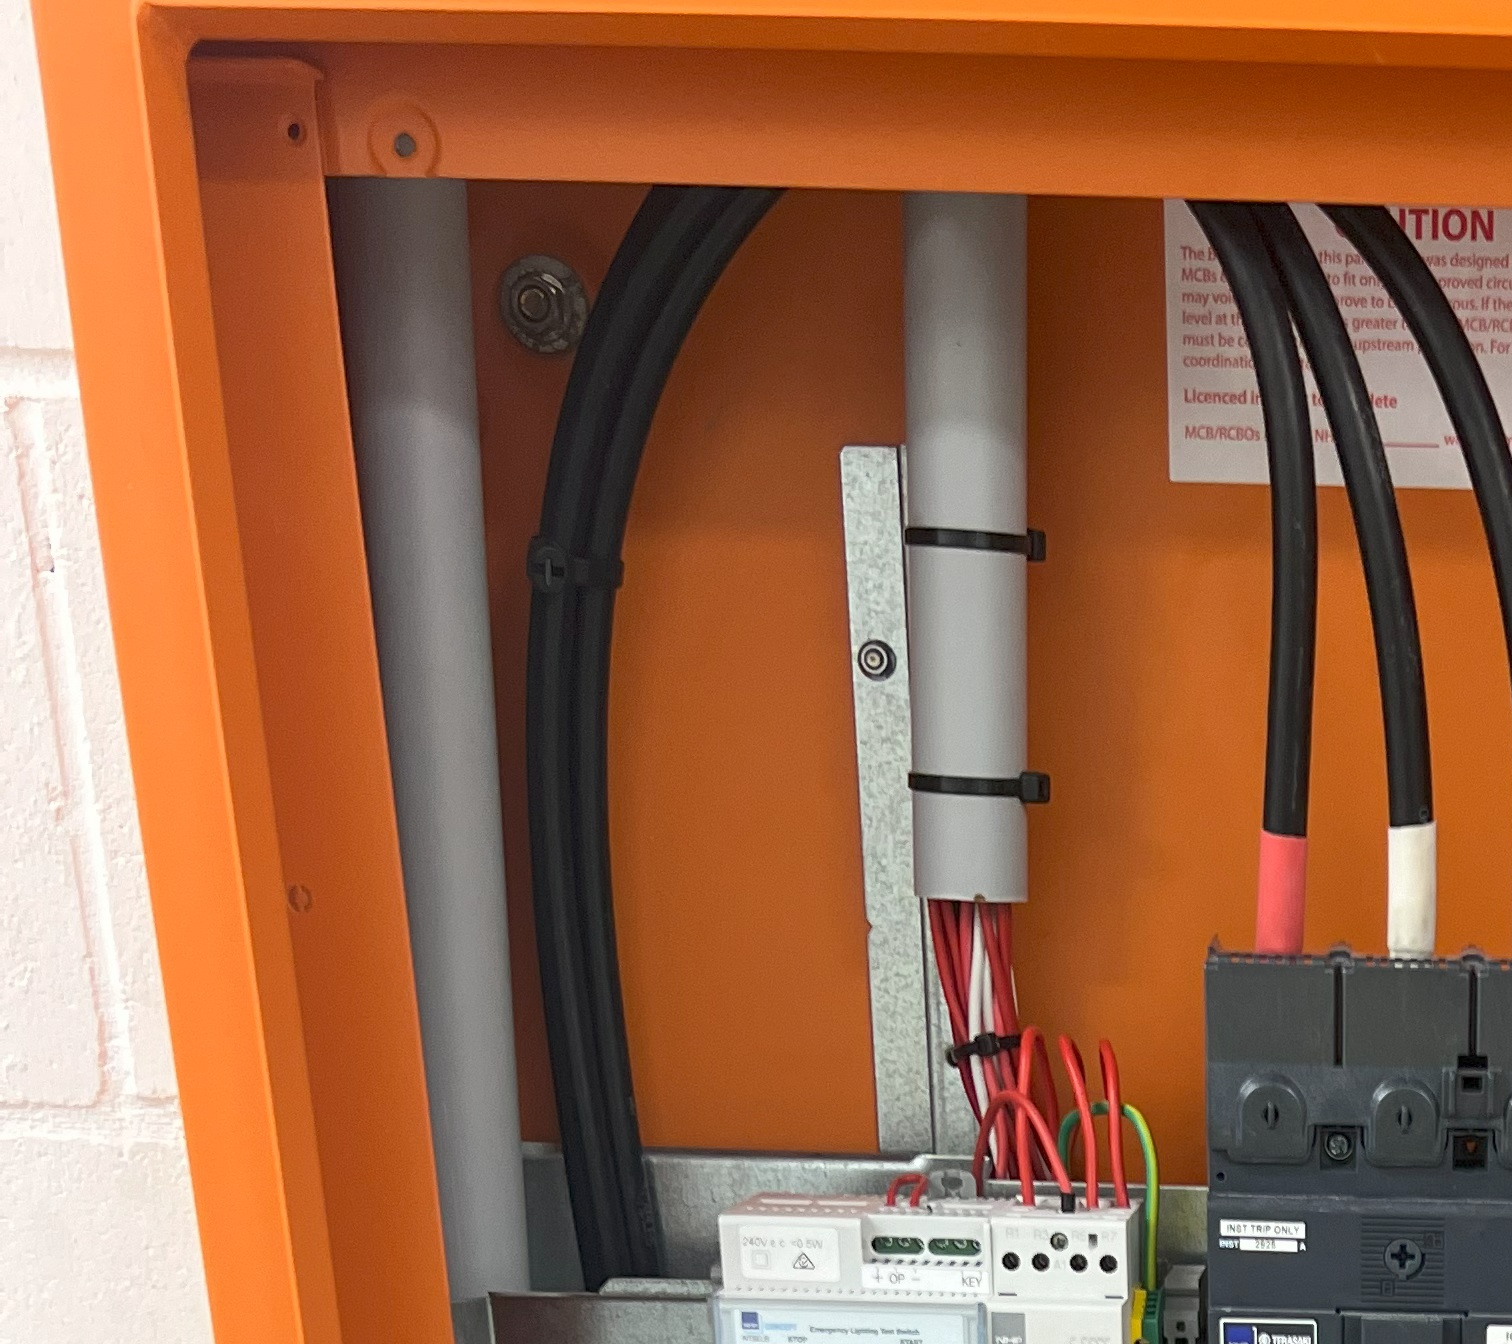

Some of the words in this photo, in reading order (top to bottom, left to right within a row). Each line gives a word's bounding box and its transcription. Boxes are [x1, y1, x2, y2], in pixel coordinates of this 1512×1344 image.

[1180, 246, 1205, 261] The
[1319, 250, 1342, 264] this
[1450, 253, 1509, 271] designed
[1181, 268, 1217, 284] MCBs
[1342, 272, 1357, 286] fit
[1182, 293, 1208, 307] may
[1371, 295, 1385, 308] to
[1481, 297, 1490, 312] If
[1493, 298, 1512, 312] the
[1182, 311, 1212, 325] level
[1215, 312, 1227, 326] at
[1353, 318, 1397, 332] greater
[1183, 333, 1215, 347] must
[1218, 332, 1234, 347] be
[1490, 340, 1511, 355] For
[1184, 387, 1247, 405] Licenced
[1185, 426, 1260, 442] MCB/RCBOs
[1227, 1224, 1248, 1233] INST
[1251, 1225, 1271, 1234] TRIP
[1274, 1225, 1300, 1235] ONLY
[889, 1273, 906, 1285] OP
[961, 1276, 982, 1288] KEY
[809, 1325, 849, 1335] Emergency
[850, 1327, 879, 1336] Lighting
